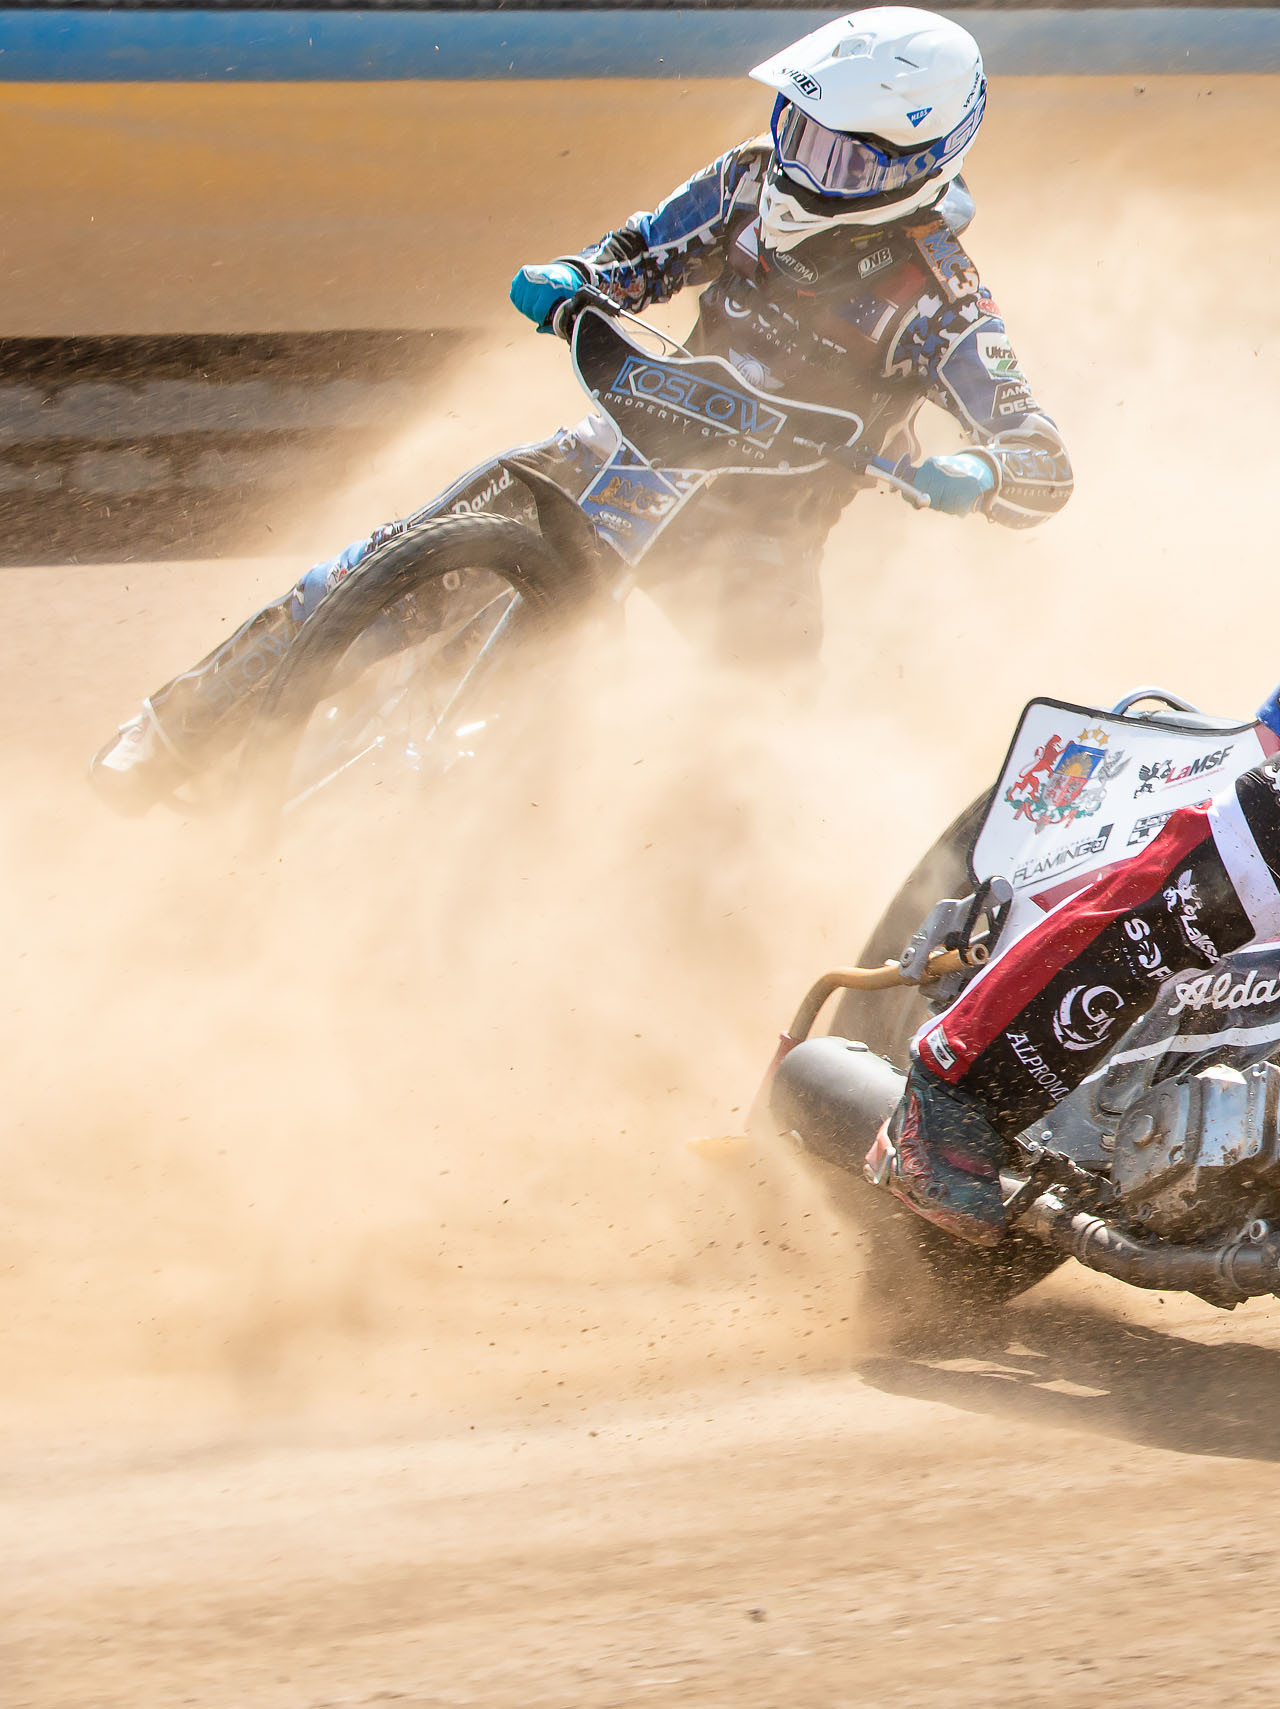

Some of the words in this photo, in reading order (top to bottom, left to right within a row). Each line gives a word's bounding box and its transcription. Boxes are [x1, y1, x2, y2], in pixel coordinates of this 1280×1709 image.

[604, 392, 691, 426] PROPERTY
[451, 467, 514, 516] David
[1164, 744, 1235, 784] LaMSF
